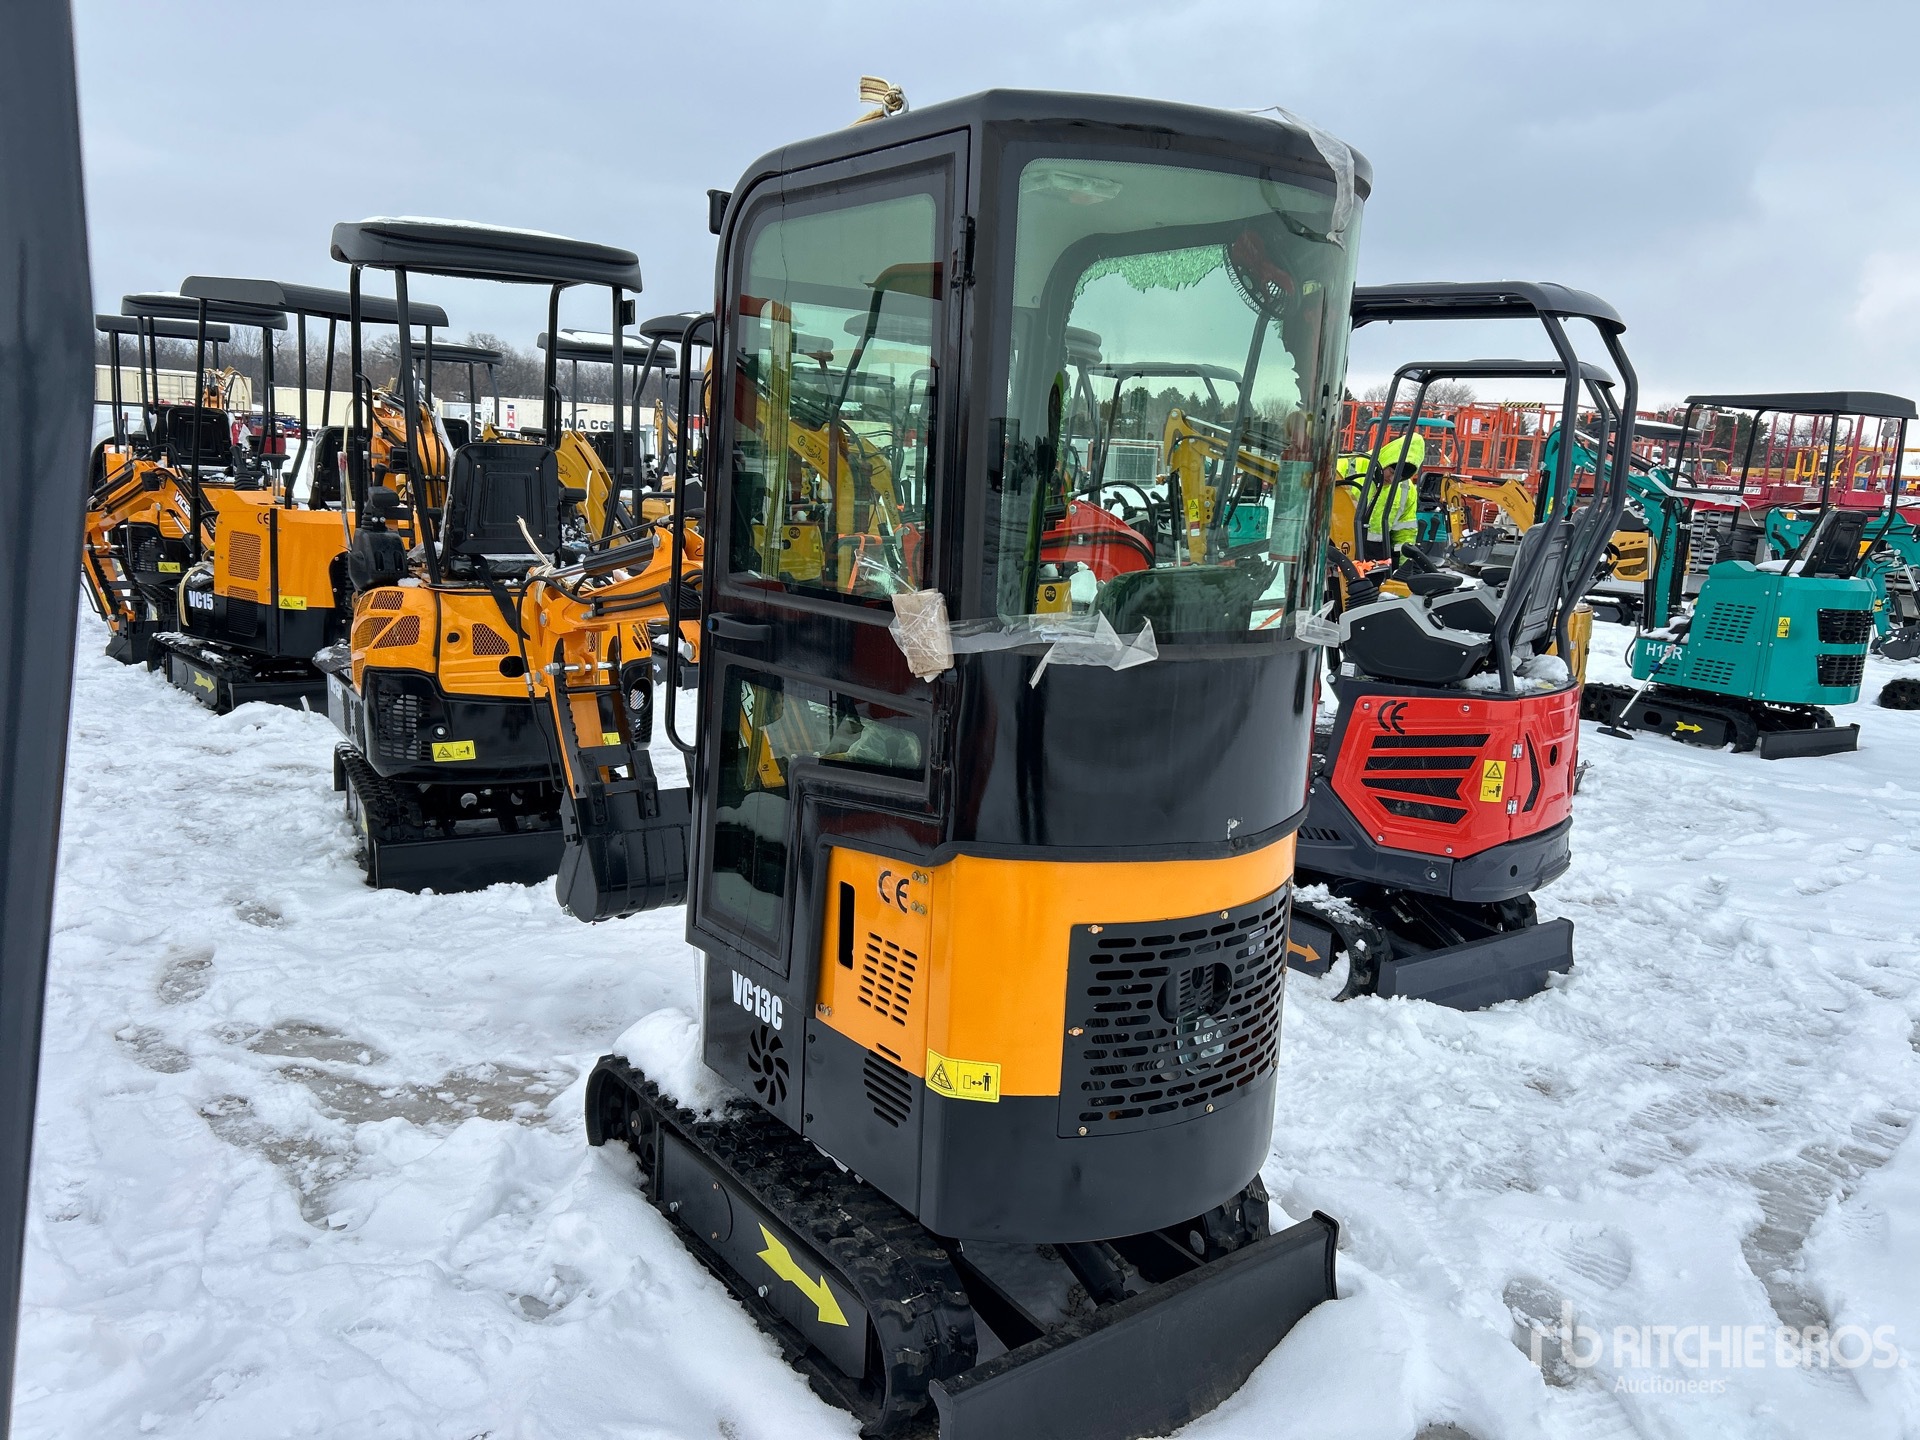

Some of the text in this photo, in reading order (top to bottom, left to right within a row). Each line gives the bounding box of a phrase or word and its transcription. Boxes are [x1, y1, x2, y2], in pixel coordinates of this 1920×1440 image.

[188, 591, 214, 611] VC15
[1377, 700, 1409, 735] CE
[879, 870, 910, 914] CE
[731, 969, 783, 1031] VC13C
